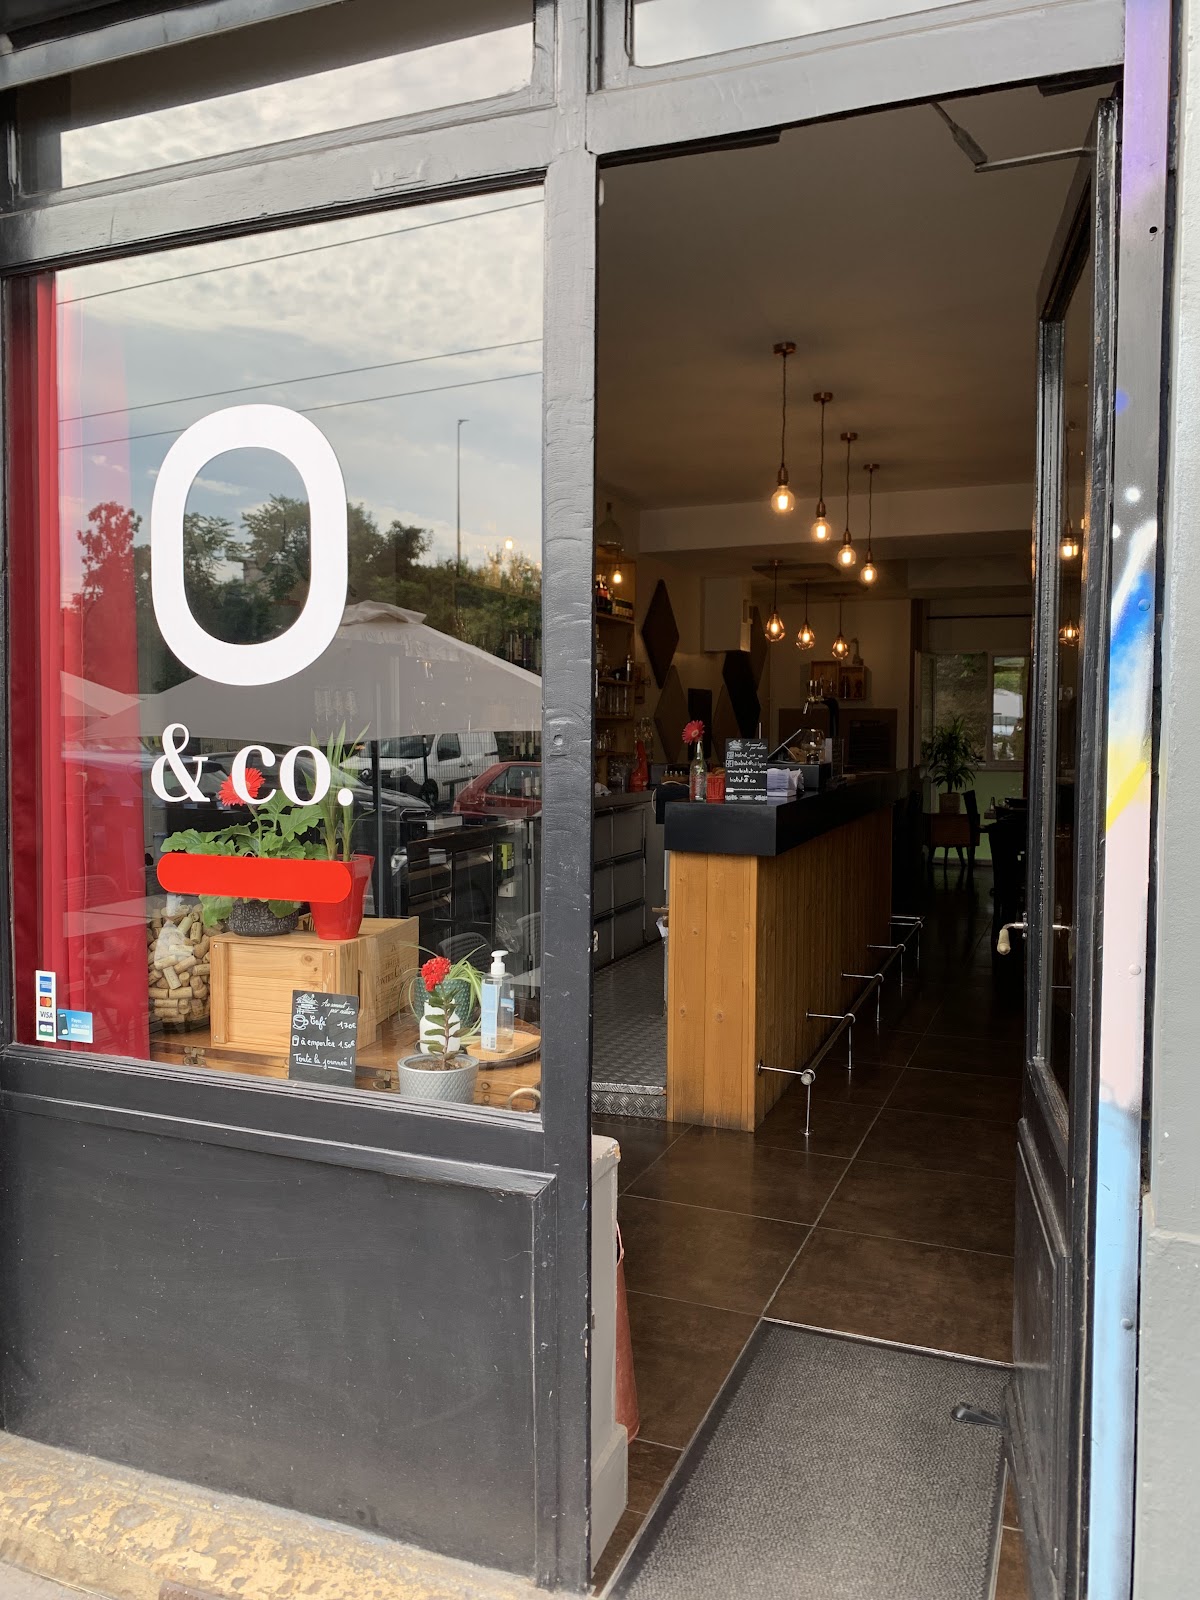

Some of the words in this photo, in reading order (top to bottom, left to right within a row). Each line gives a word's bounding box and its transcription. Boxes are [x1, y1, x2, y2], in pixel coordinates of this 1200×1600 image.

[151, 404, 348, 686] O
[151, 723, 210, 804] &
[231, 745, 354, 806] co.
[40, 1011, 53, 1019] VISA
[310, 1015, 327, 1030] Café
[307, 1036, 336, 1050] emporter
[293, 1053, 312, 1063] Toute
[314, 1053, 321, 1064] la
